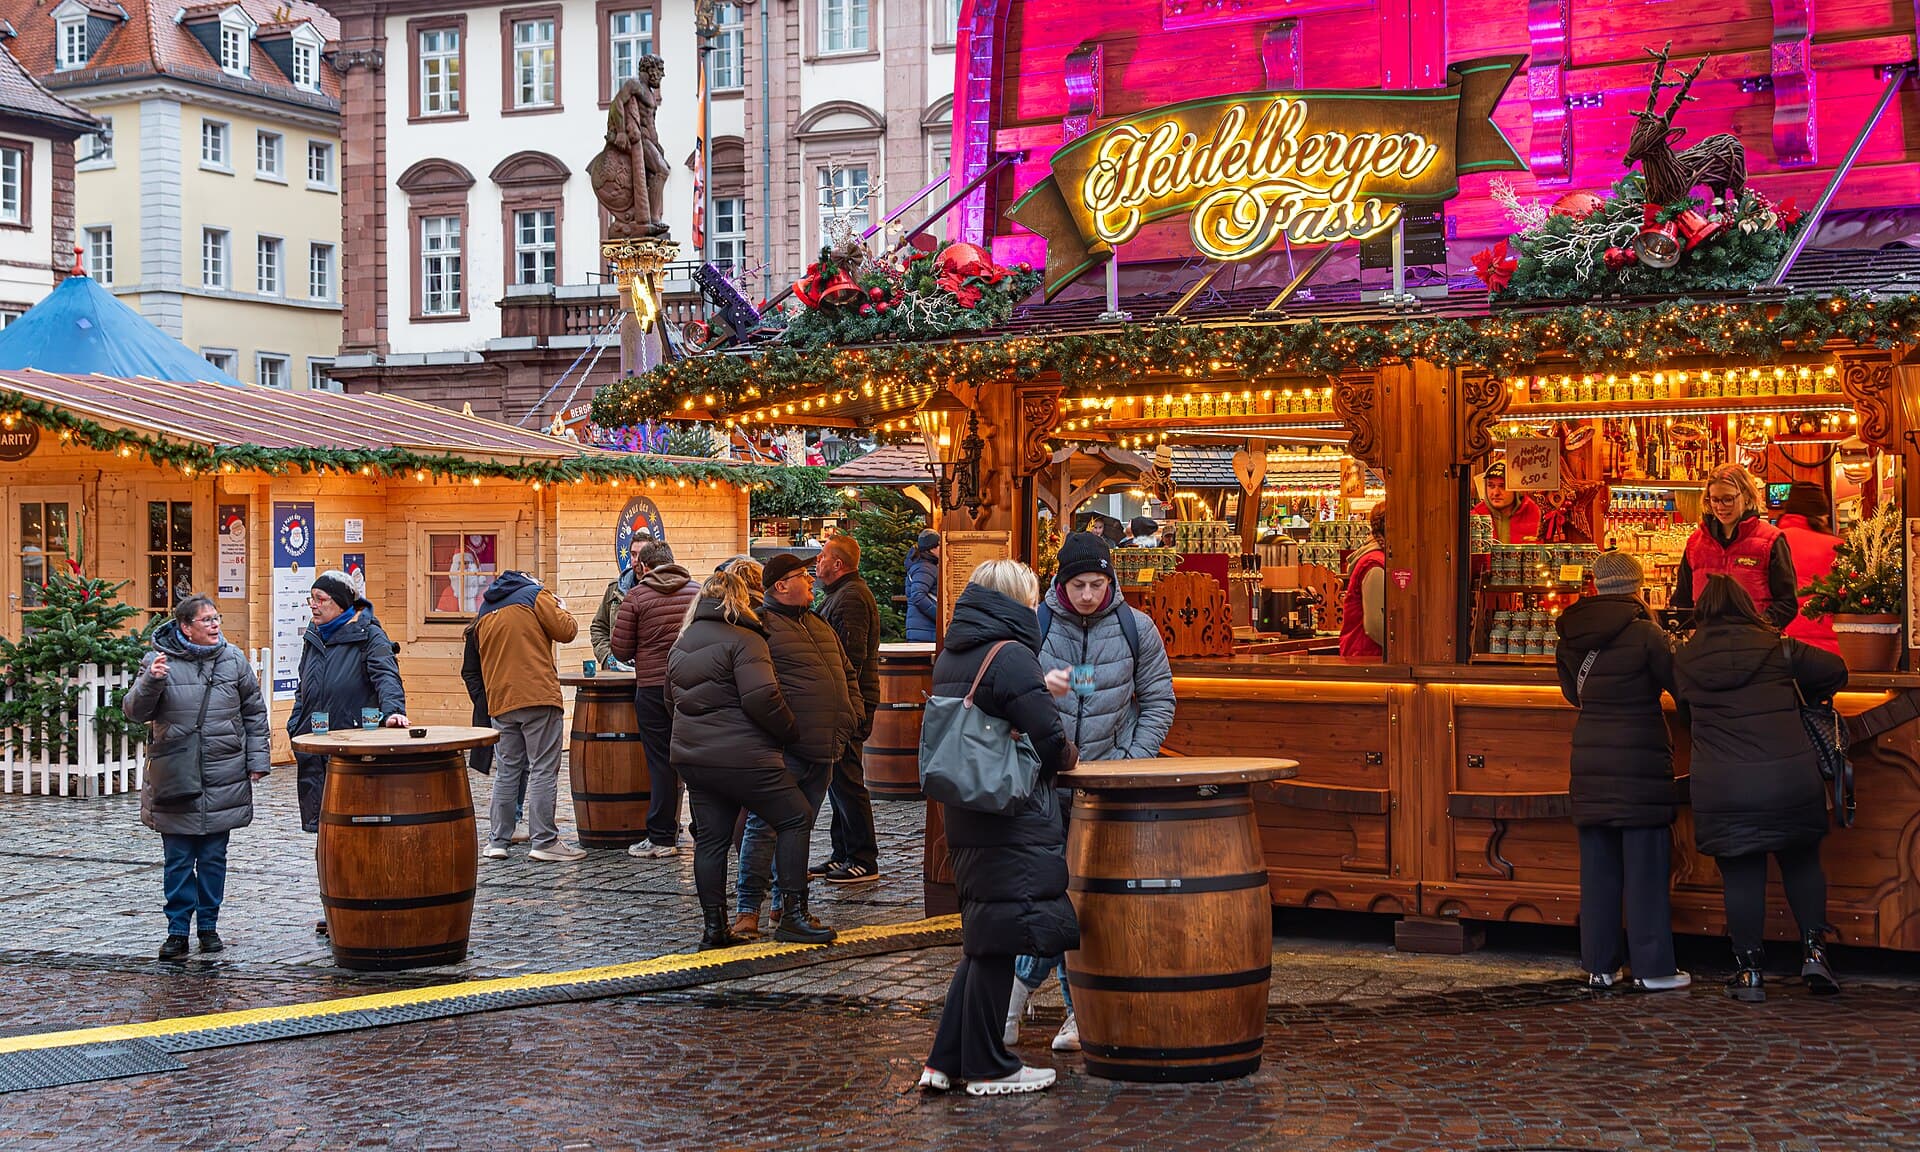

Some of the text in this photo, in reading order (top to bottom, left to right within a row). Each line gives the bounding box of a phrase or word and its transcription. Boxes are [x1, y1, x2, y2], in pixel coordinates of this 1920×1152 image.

[1084, 98, 1440, 244] Heidelberger
[1190, 179, 1403, 262] Fass
[0, 433, 31, 446] ARITY
[1520, 473, 1541, 486] 6,50
